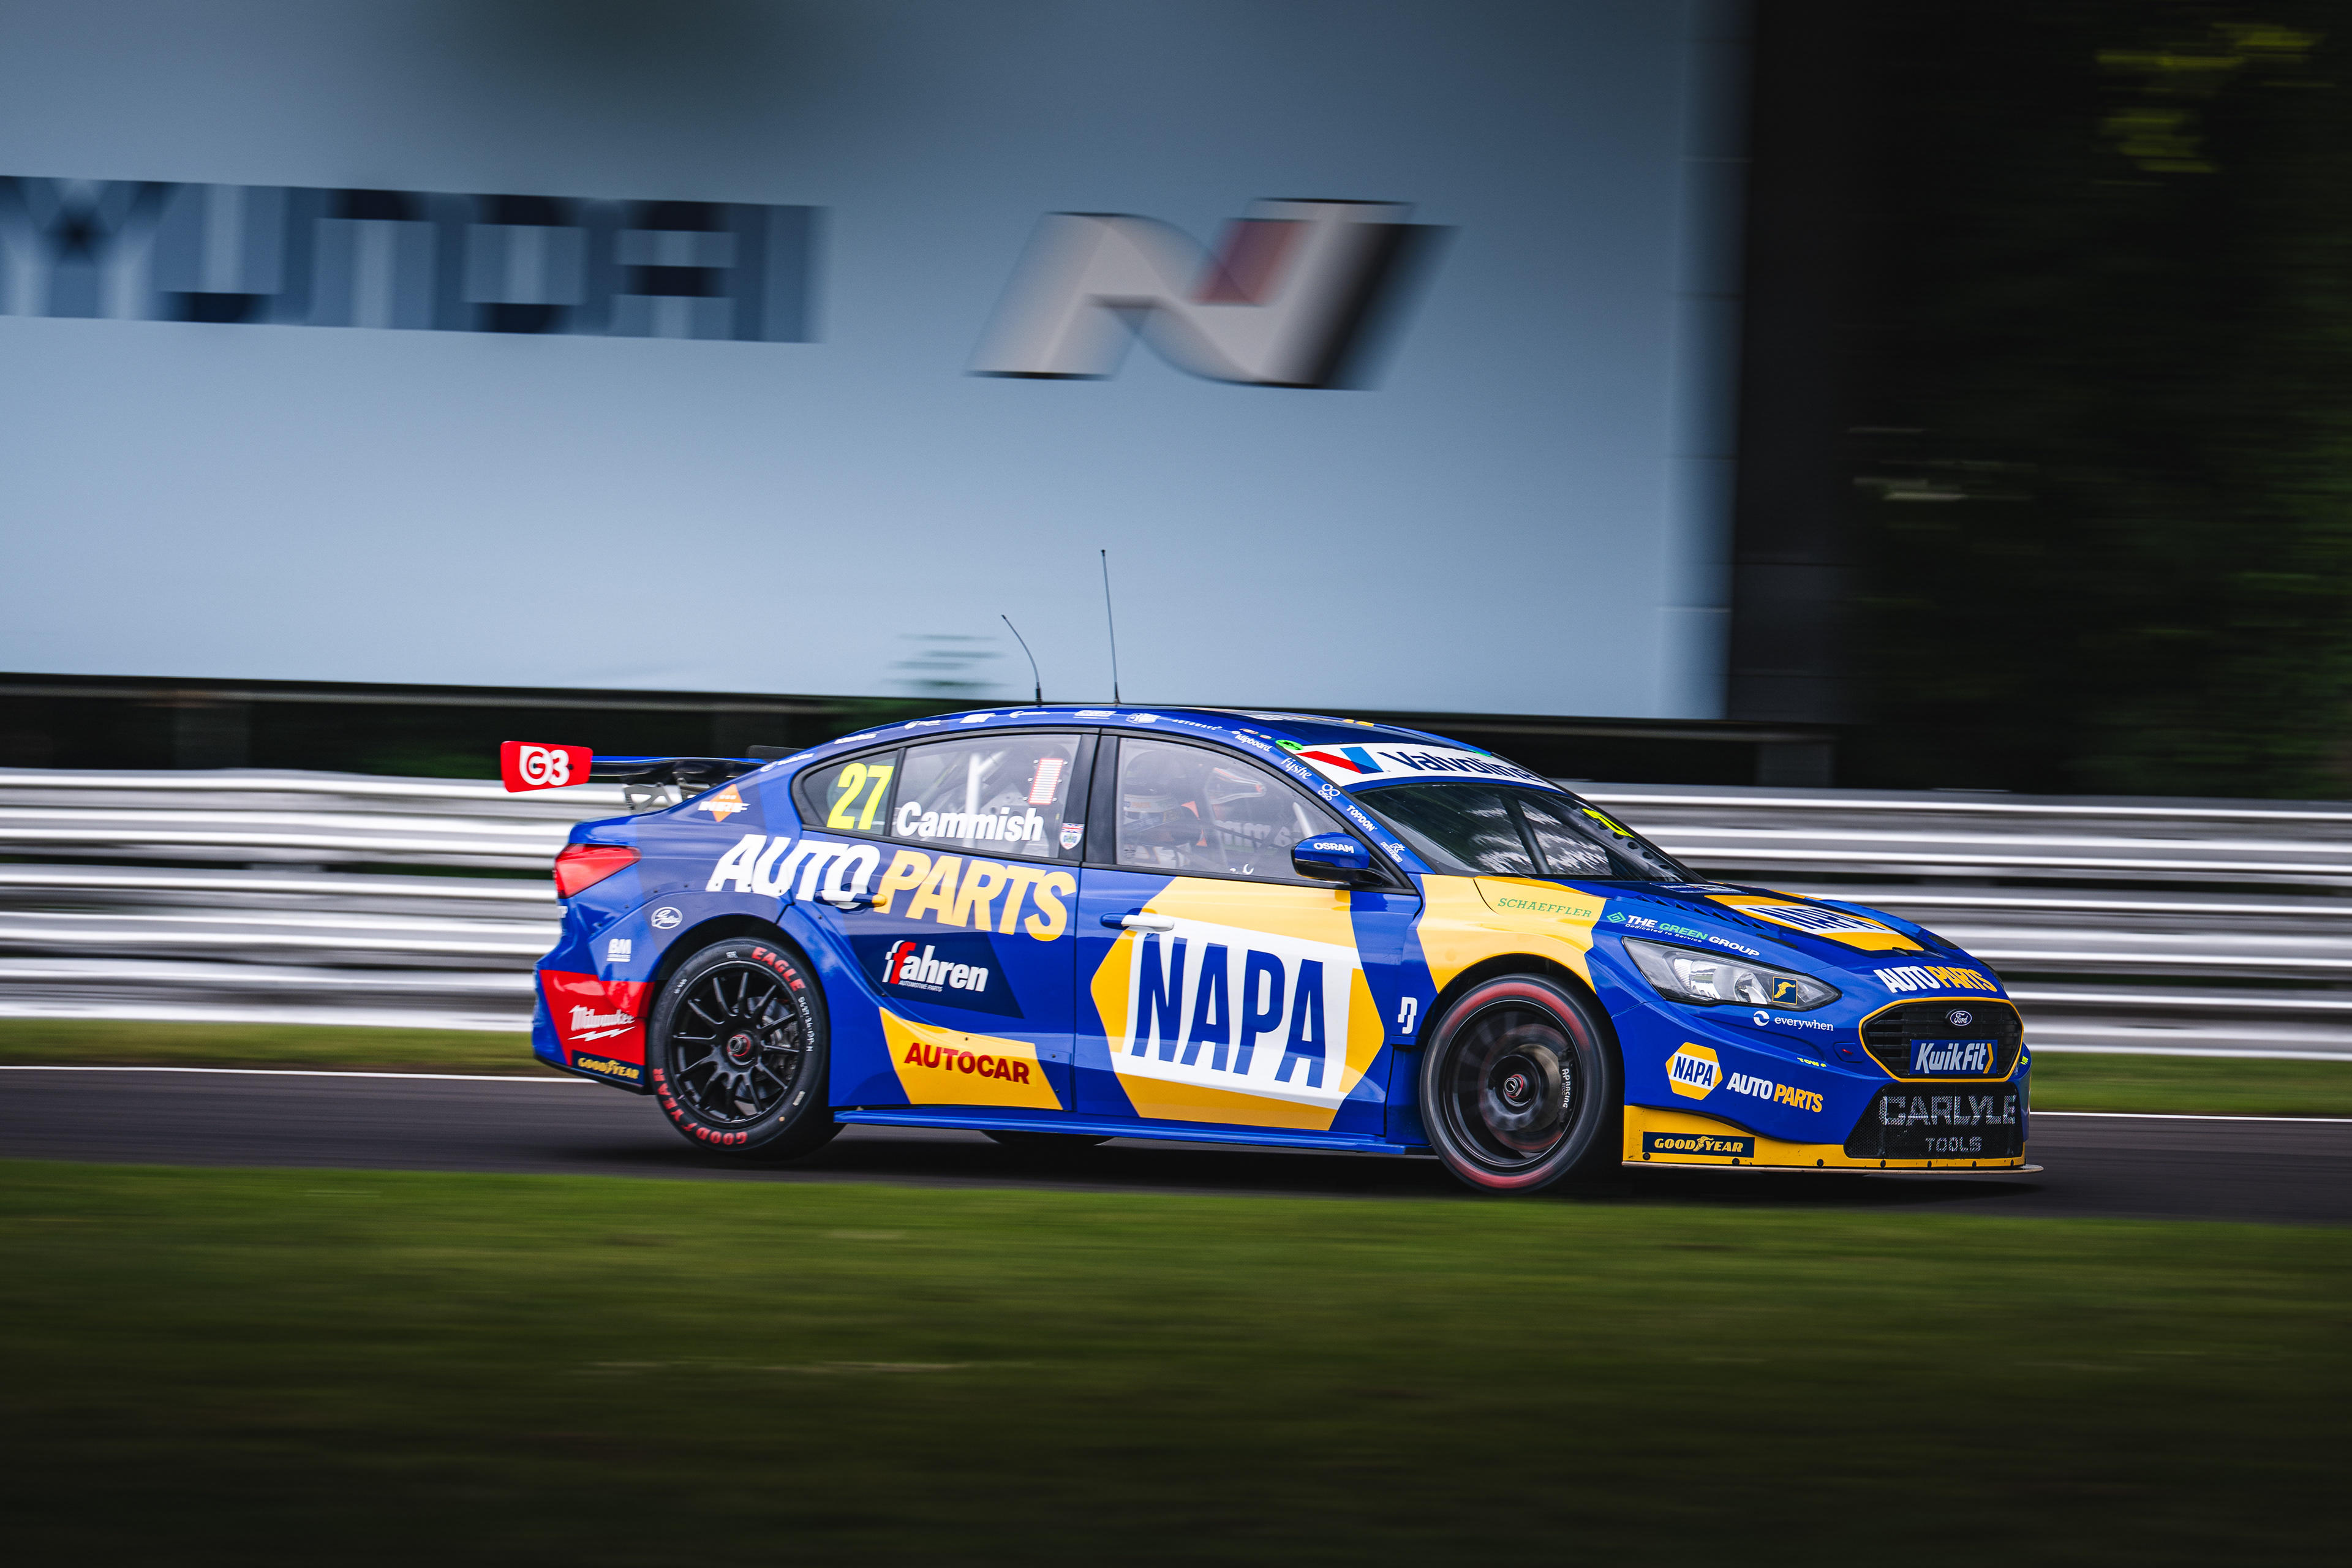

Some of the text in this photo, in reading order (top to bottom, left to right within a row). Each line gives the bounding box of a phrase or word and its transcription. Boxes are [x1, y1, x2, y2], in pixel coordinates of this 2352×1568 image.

[1377, 752, 1546, 783] Valvoline
[827, 763, 894, 829] 27
[897, 801, 1044, 842] Cammish
[1346, 805, 1376, 832] TOPDON
[1314, 842, 1355, 854] OSRAM
[706, 834, 1076, 941] AUTO PARTS
[1498, 898, 1592, 918] SCHAEFFLER
[1625, 924, 1663, 933] Dedicated
[1675, 933, 1703, 943] Service
[1627, 914, 1760, 956] THE GREEN GROUP
[751, 947, 807, 992] EAGLE
[882, 940, 989, 992] fahren
[1873, 965, 1997, 993] AUTO PARTS
[1132, 935, 1325, 1089] NAPA
[1774, 1017, 1834, 1031] everywhen
[1954, 1013, 1969, 1024] Ford
[578, 1058, 639, 1079] GOODYEAR
[904, 1042, 1030, 1085] AUTOCAR
[1673, 1055, 1714, 1087] NAPA
[652, 1068, 748, 1145] GOODYEAR
[1726, 1072, 1823, 1113] AUTO PARTS
[1879, 1095, 2016, 1126] CARLYLE
[1654, 1136, 1744, 1152] GOODYEAR
[1925, 1136, 1982, 1152] TOOLS
